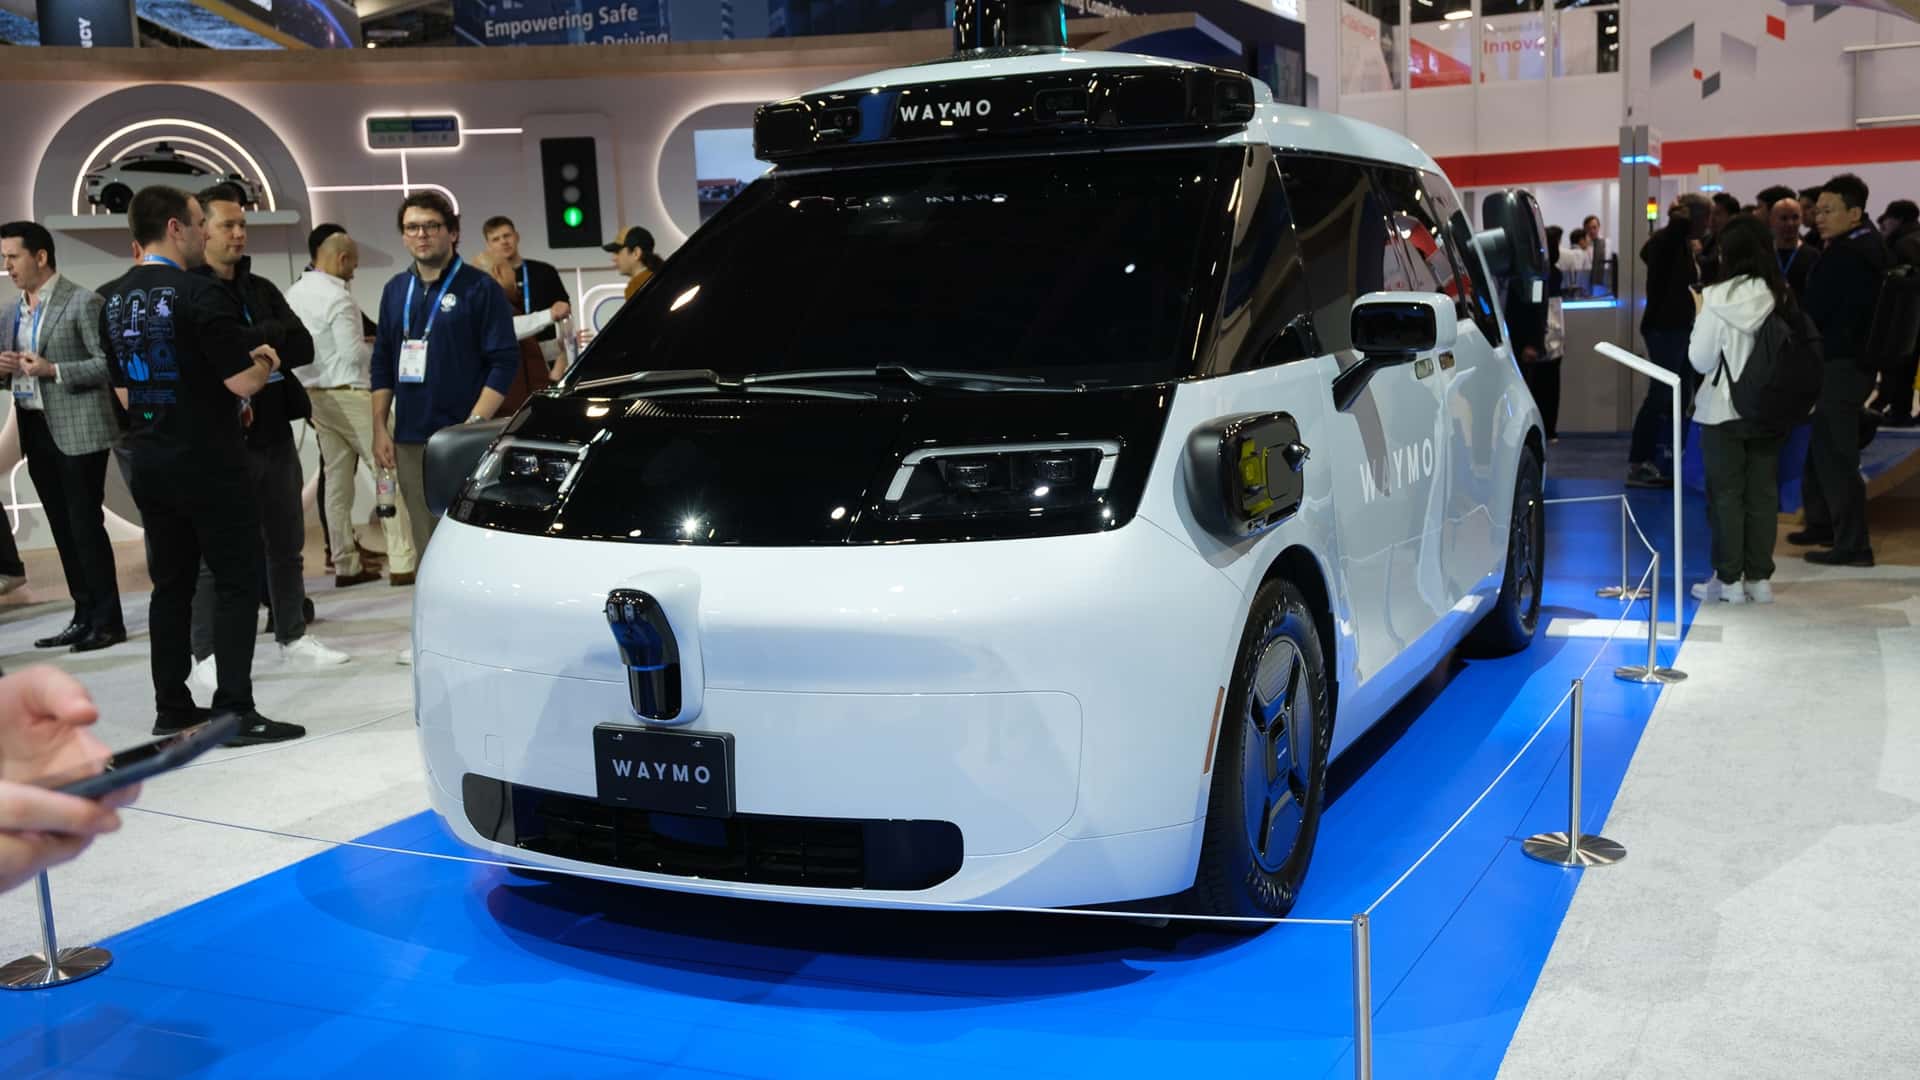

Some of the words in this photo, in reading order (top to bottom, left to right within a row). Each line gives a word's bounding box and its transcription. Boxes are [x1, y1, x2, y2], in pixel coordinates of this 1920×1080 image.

[484, 10, 594, 39] Empowering
[599, 5, 639, 25] Safe
[900, 99, 992, 122] WAYMO
[1360, 437, 1433, 504] WAYMO
[612, 758, 711, 784] WAYMO
